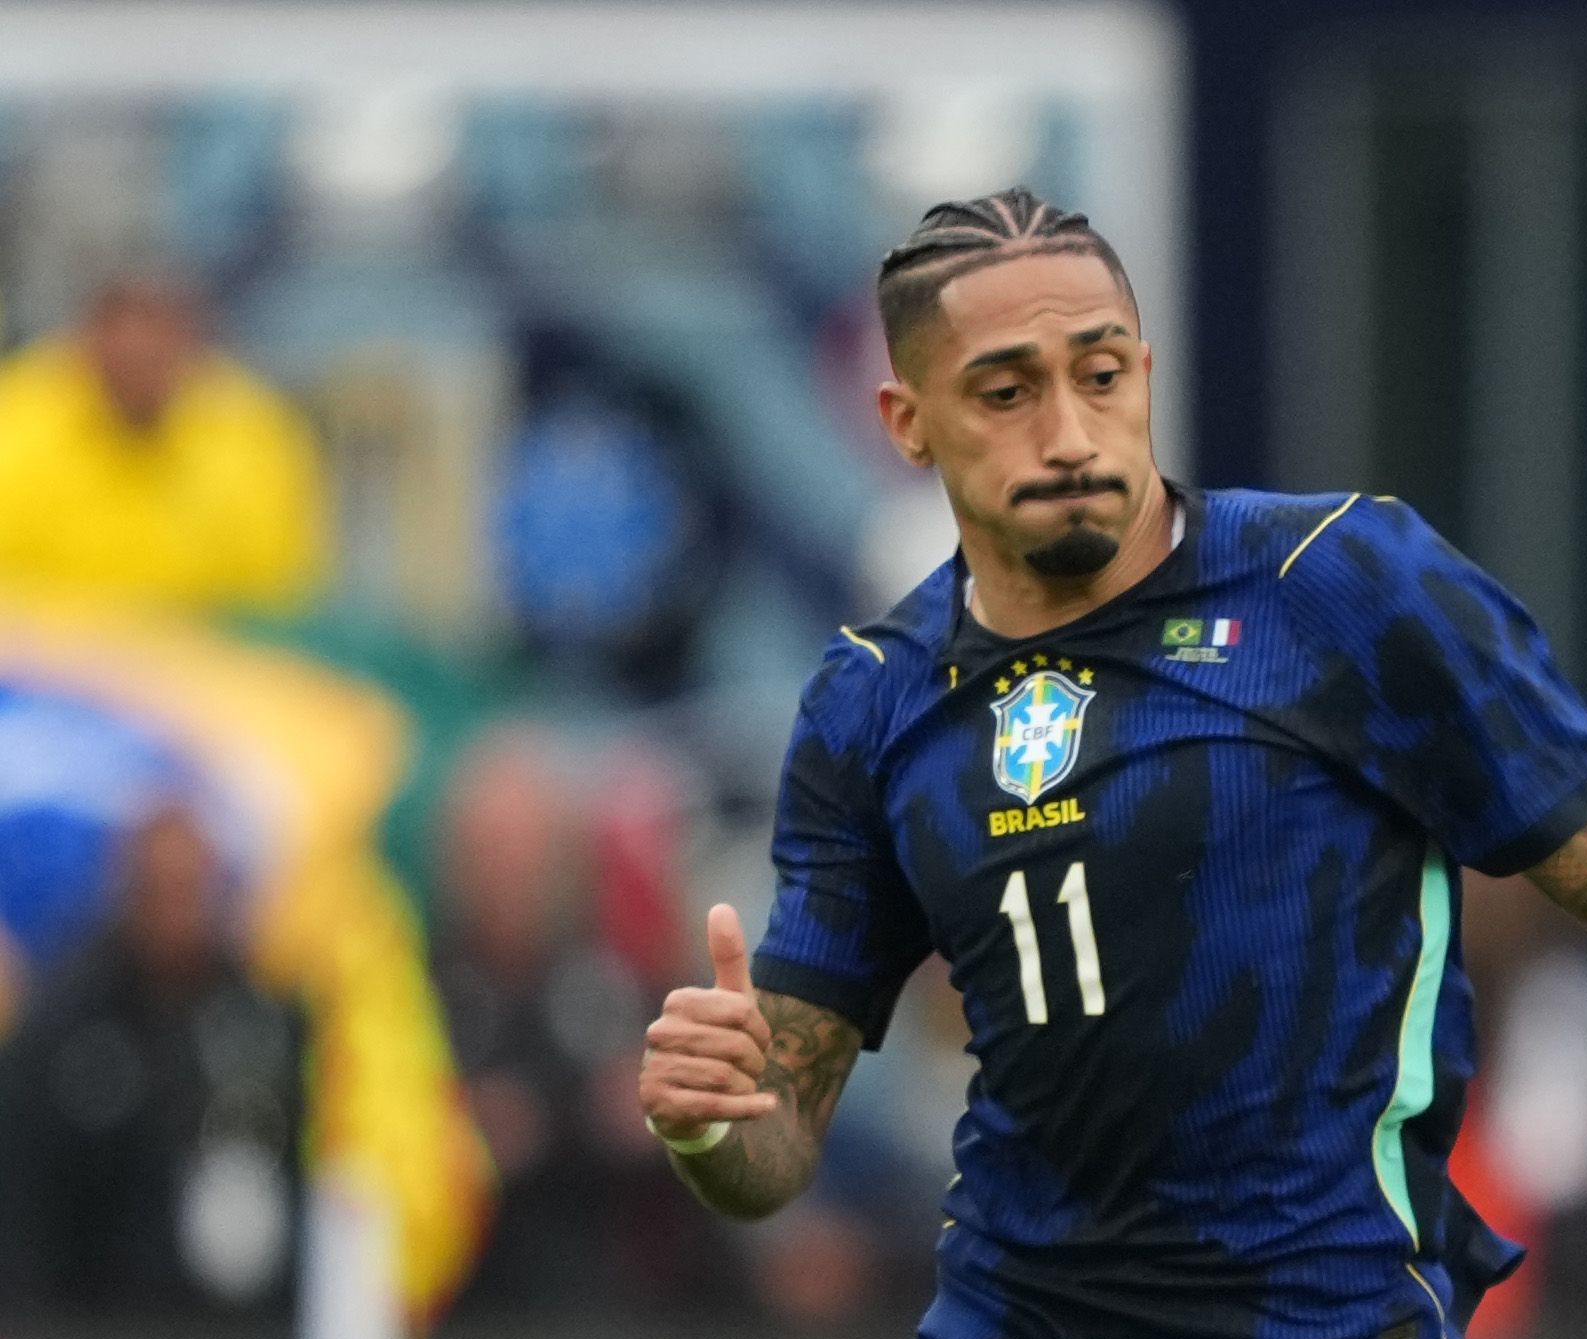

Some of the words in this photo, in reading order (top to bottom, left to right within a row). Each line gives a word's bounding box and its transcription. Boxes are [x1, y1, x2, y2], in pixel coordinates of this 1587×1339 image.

[1022, 724, 1054, 741] CBF
[989, 798, 1086, 837] BRASIL
[999, 861, 1105, 1024] 11
